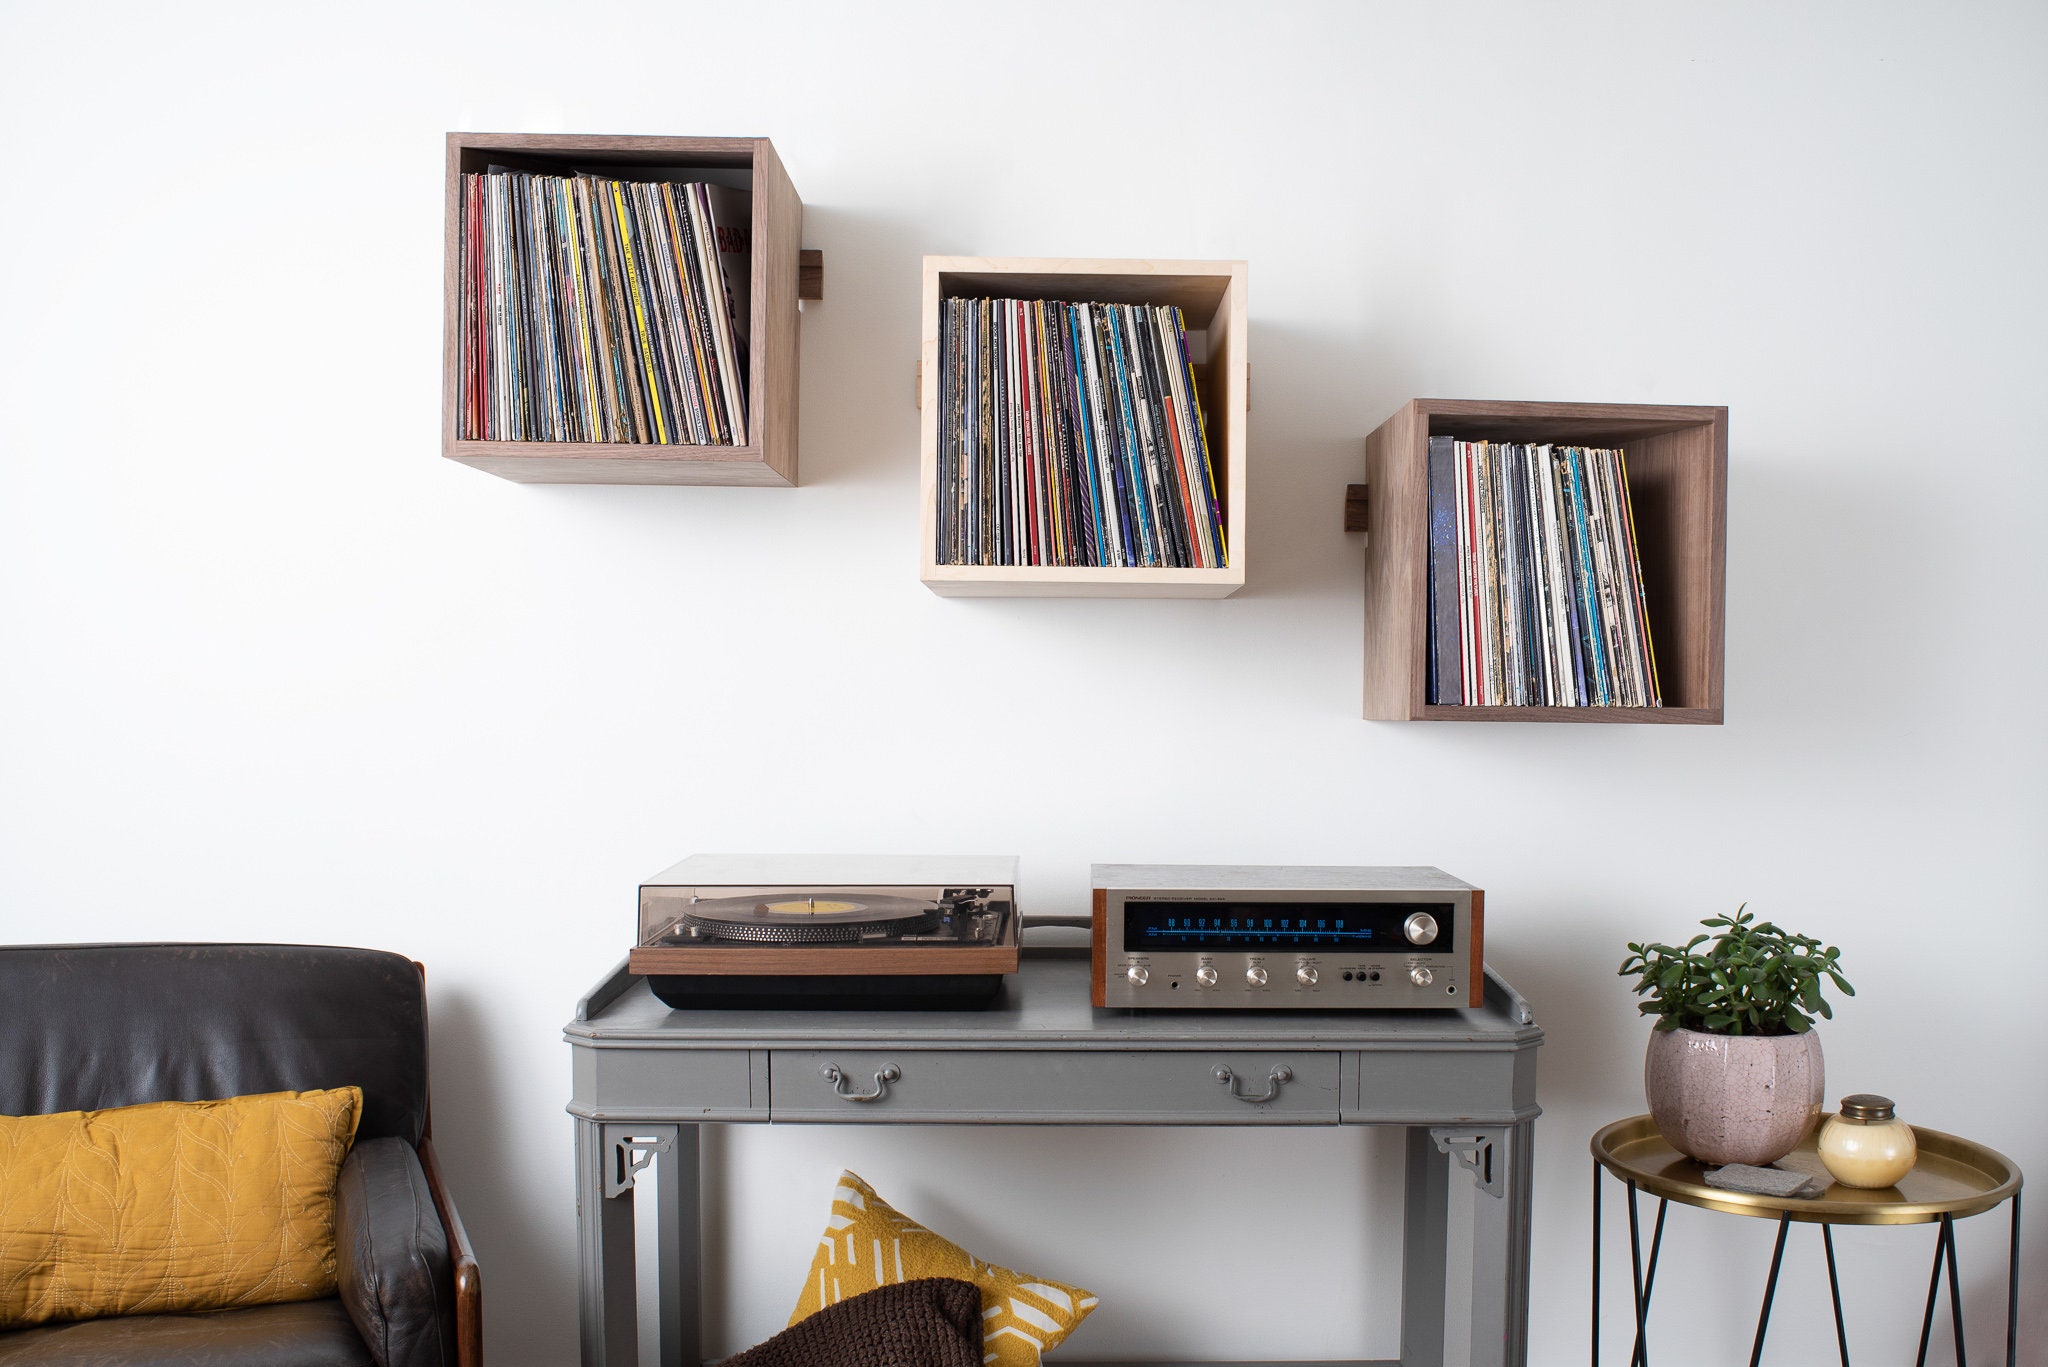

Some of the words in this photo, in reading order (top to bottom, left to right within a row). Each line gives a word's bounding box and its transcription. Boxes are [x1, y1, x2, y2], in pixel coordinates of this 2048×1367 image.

[629, 275, 640, 306] BROTHERS
[643, 346, 652, 374] SADNESS
[1168, 918, 1175, 927] 88
[1183, 918, 1191, 927] 90
[1198, 918, 1205, 927] 92
[1213, 918, 1221, 927] 94
[1230, 918, 1238, 927] 96
[1246, 918, 1254, 927] 98
[1263, 919, 1272, 928] 100
[1336, 919, 1344, 928] 108
